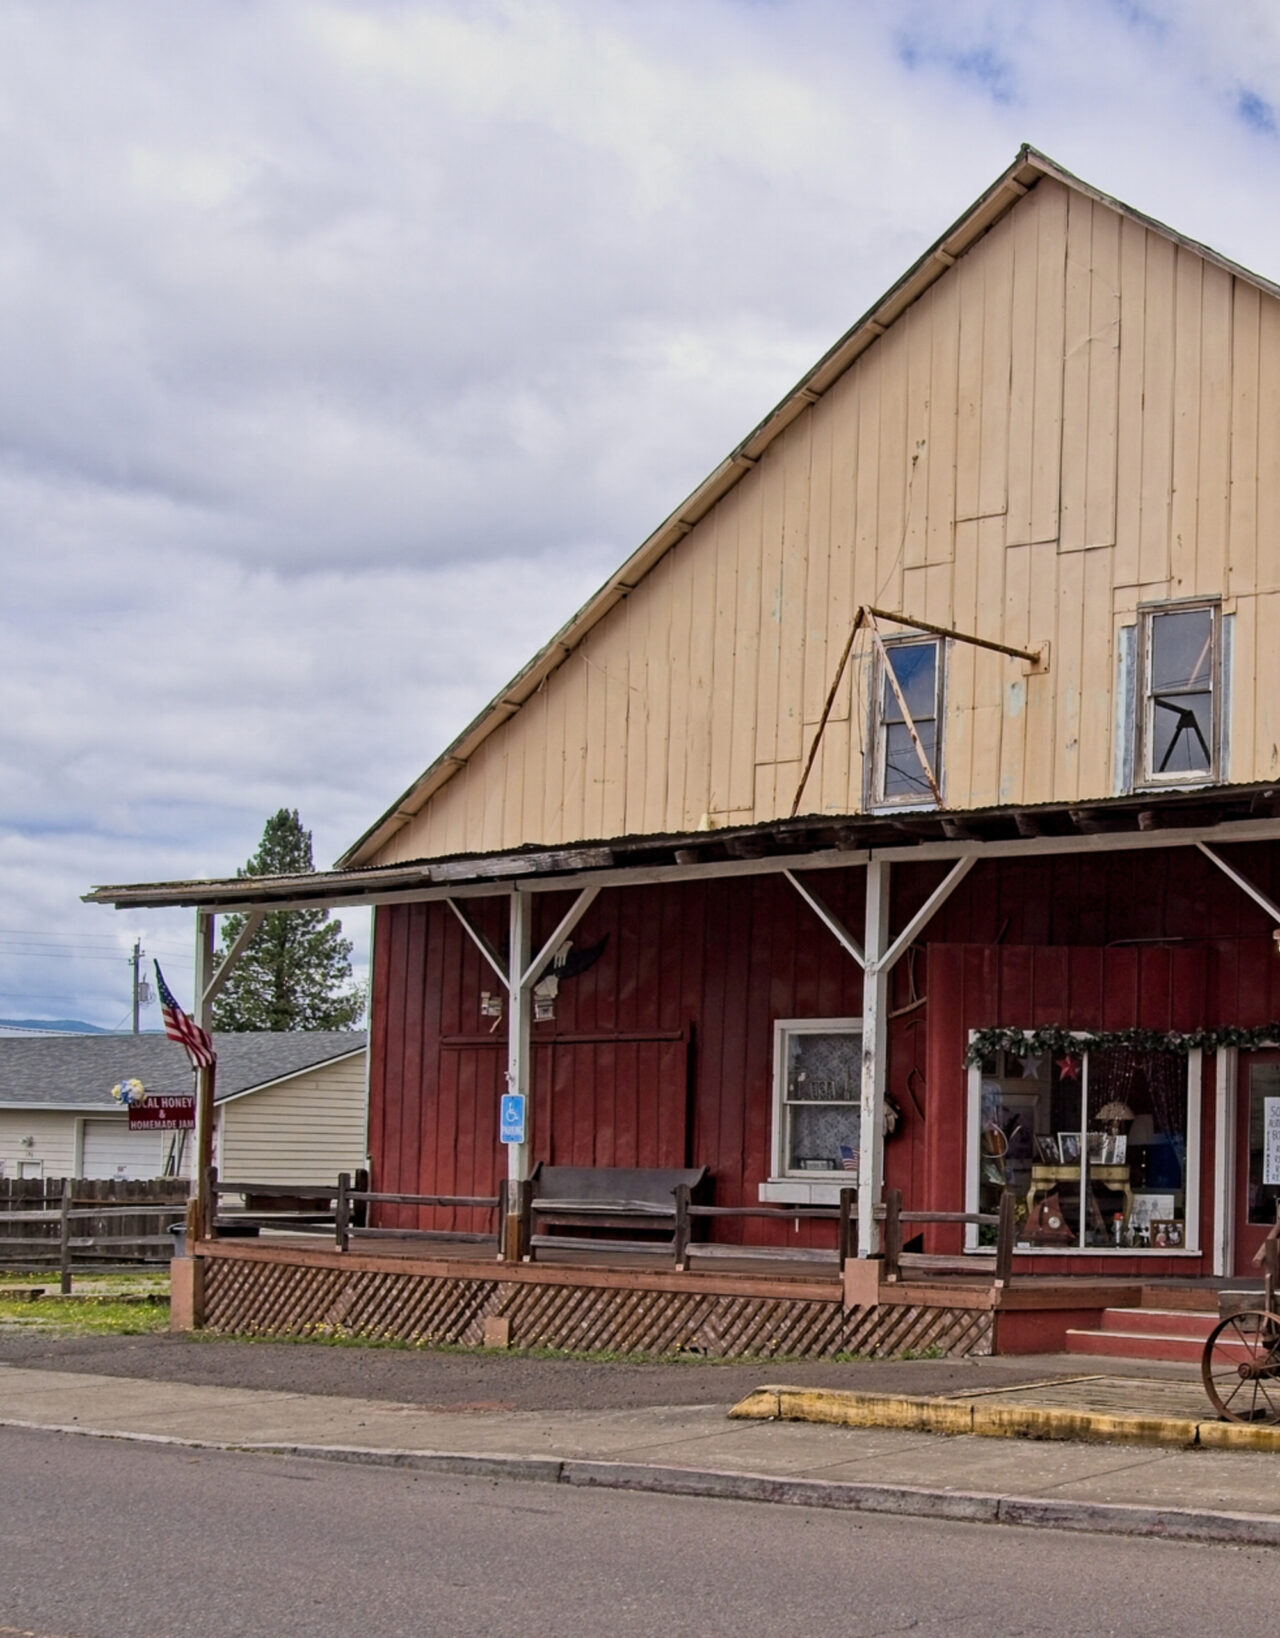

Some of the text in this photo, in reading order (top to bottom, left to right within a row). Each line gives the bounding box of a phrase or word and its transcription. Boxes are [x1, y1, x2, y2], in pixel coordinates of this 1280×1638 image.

[130, 1098, 193, 1109] LOCAL HONEY
[159, 1109, 166, 1119] &
[130, 1120, 195, 1130] HOMEMADE JAM
